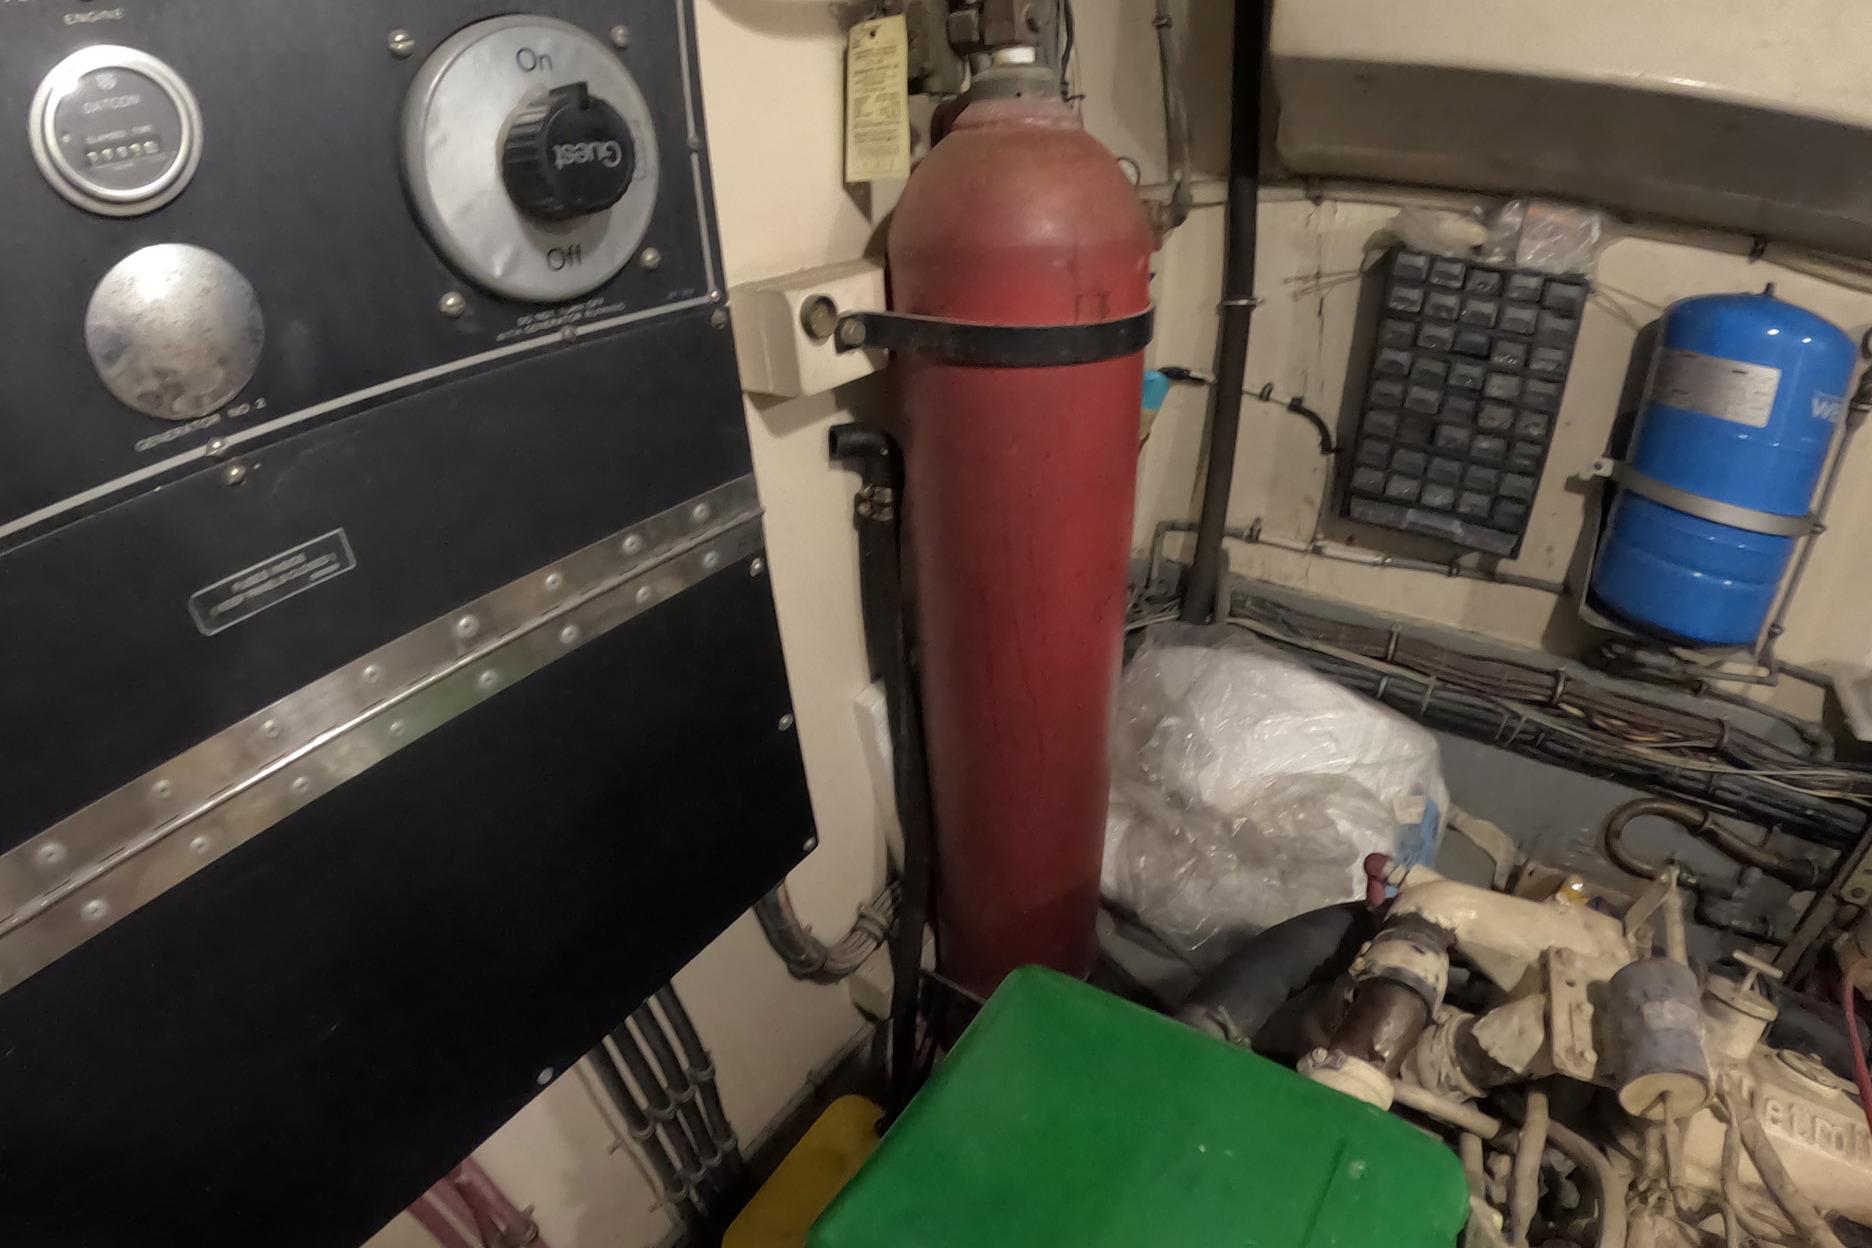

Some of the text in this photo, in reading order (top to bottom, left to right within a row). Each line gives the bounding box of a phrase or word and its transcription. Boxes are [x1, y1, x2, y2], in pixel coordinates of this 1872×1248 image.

[516, 47, 552, 74] On
[552, 140, 622, 169] Guest
[546, 244, 584, 271] Off
